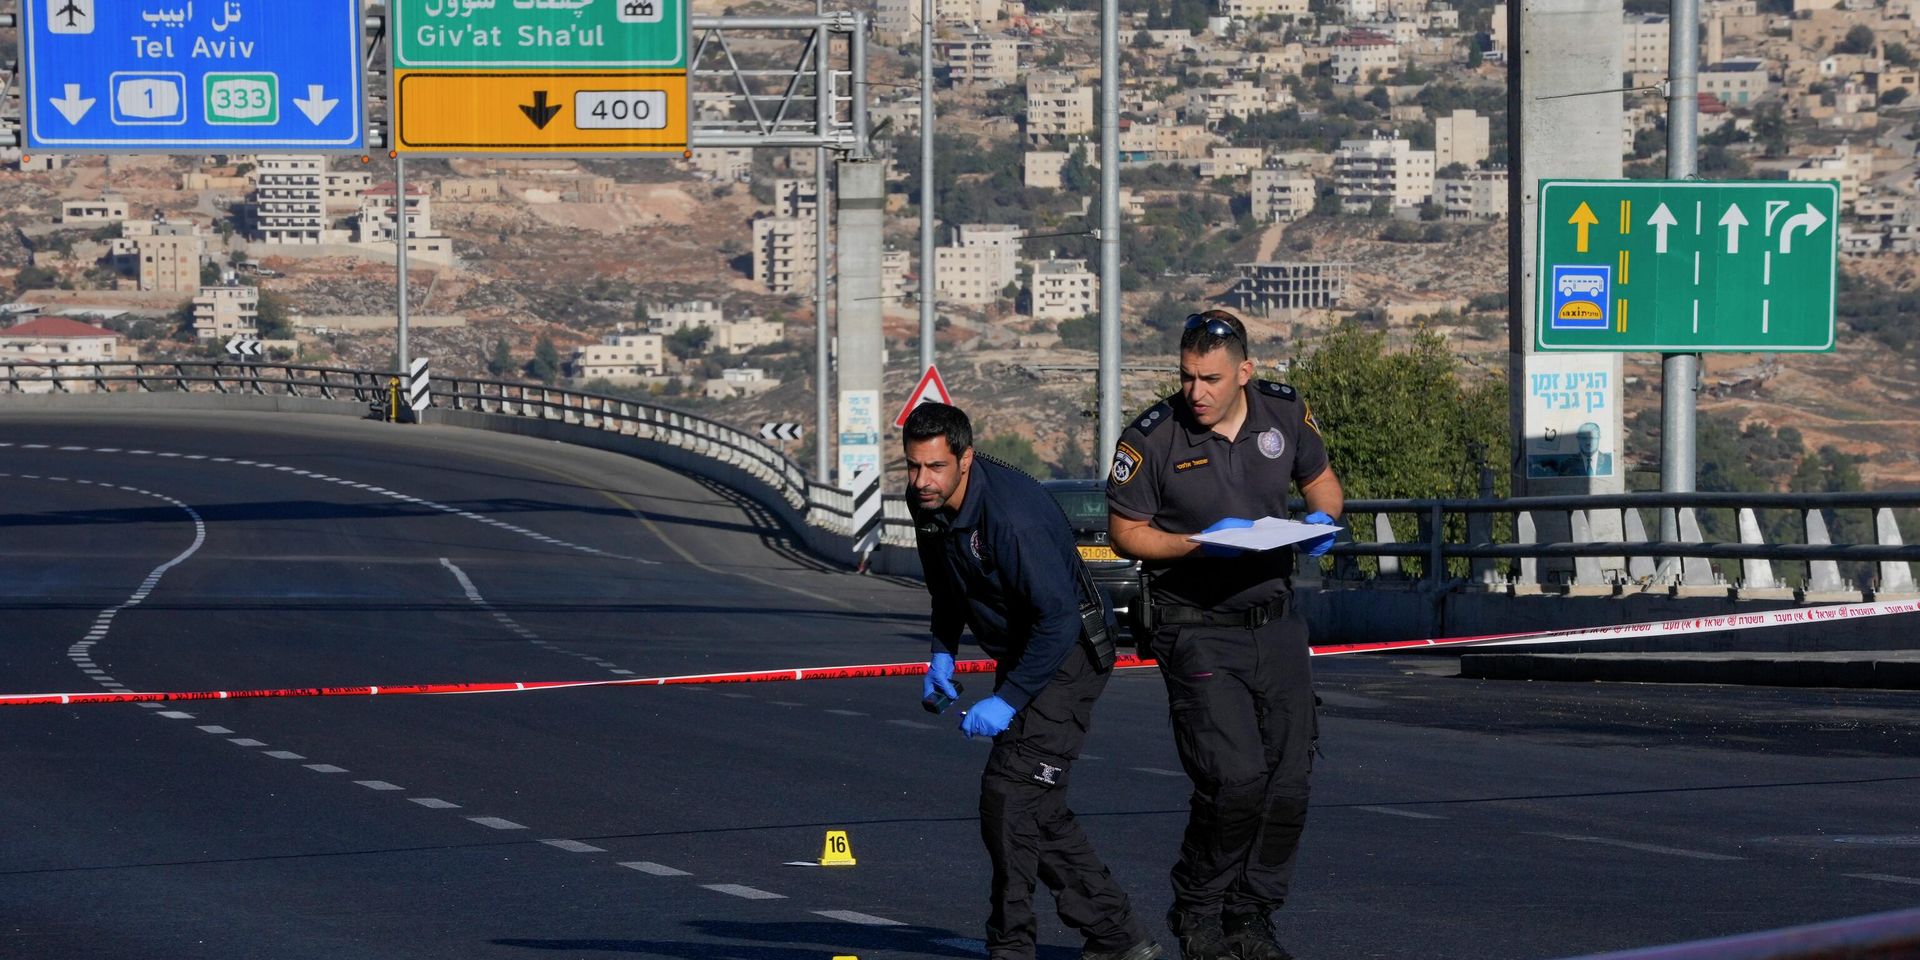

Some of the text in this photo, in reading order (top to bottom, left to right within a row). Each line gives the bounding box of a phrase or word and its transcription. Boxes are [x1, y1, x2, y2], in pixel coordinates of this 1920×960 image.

[417, 24, 604, 47] Giv'at Sha'ul
[131, 35, 254, 58] Tel Aviv
[144, 88, 153, 109] 1
[216, 88, 266, 109] 333
[591, 99, 649, 120] 400
[1531, 371, 1607, 396] הגיע זמן
[1540, 391, 1605, 413] בן גביר
[828, 836, 846, 853] 16
